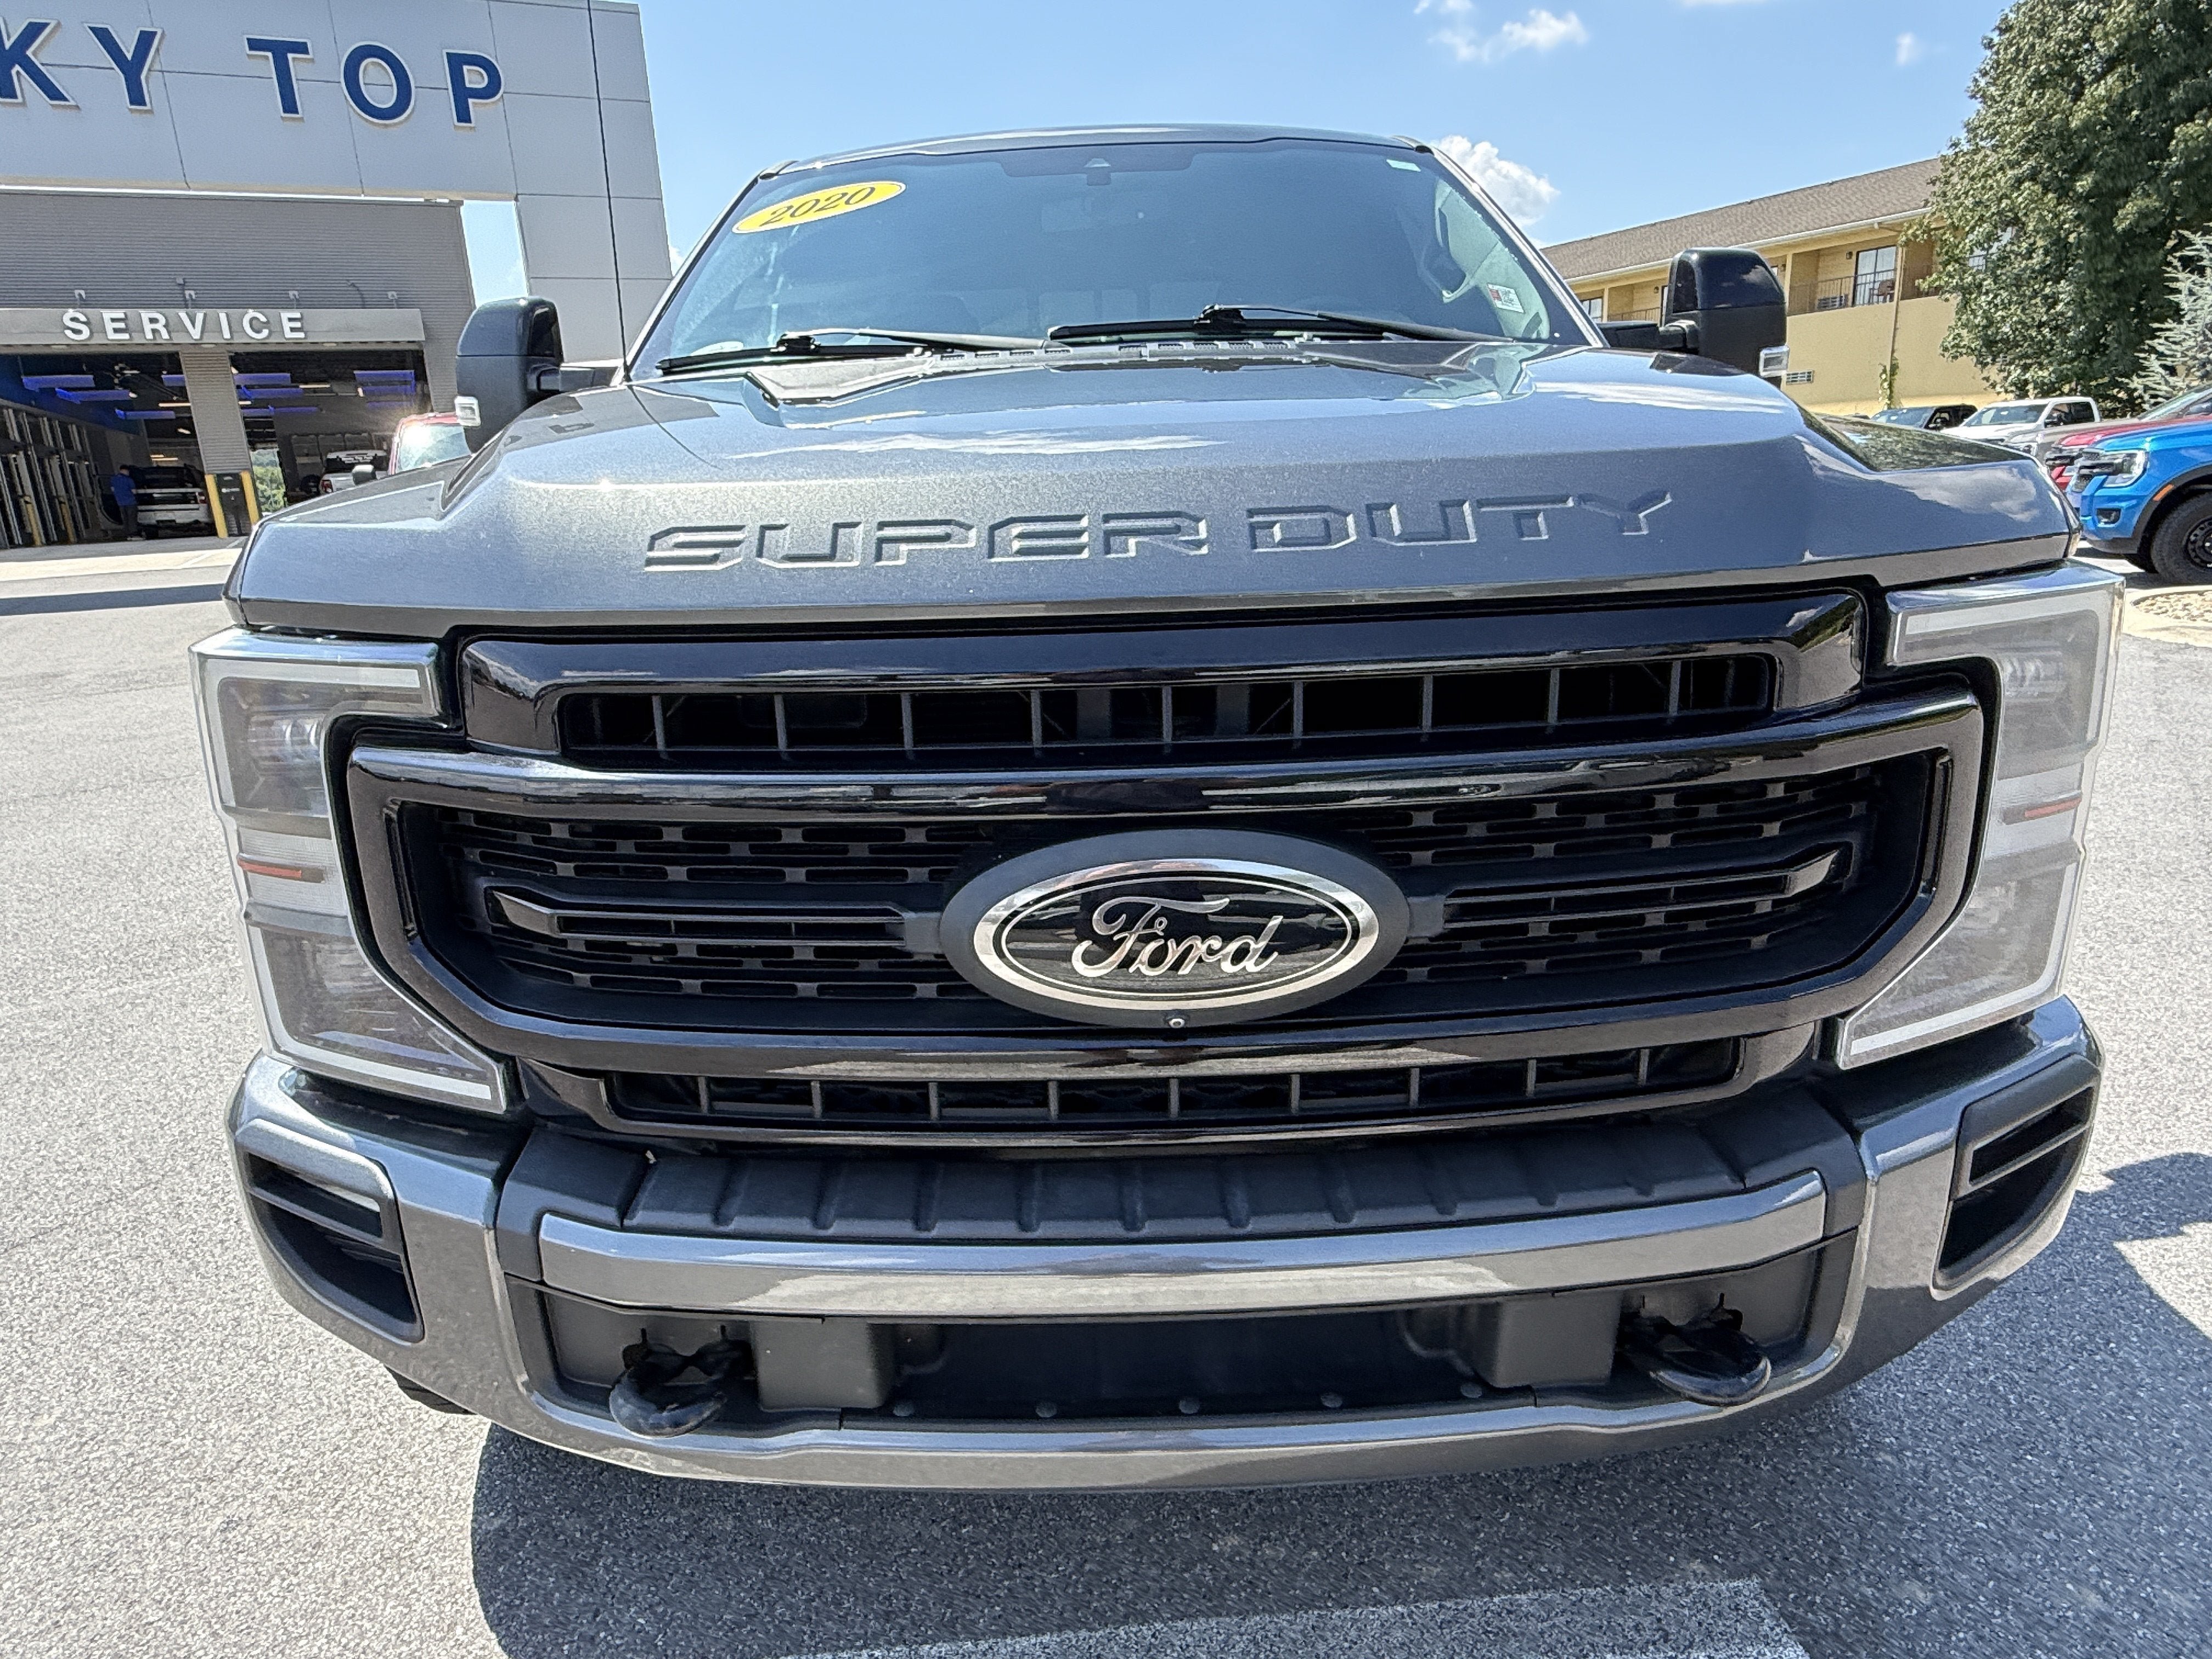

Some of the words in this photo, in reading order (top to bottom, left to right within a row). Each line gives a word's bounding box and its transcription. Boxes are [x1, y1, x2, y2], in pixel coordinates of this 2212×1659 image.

[0, 16, 163, 110] KY
[244, 34, 504, 127] TOP
[760, 186, 876, 227] 2020
[63, 311, 306, 341] SERVICE
[644, 510, 1209, 572] SUPER
[1246, 490, 1672, 553] DUTY
[1071, 896, 1285, 978] Ford
